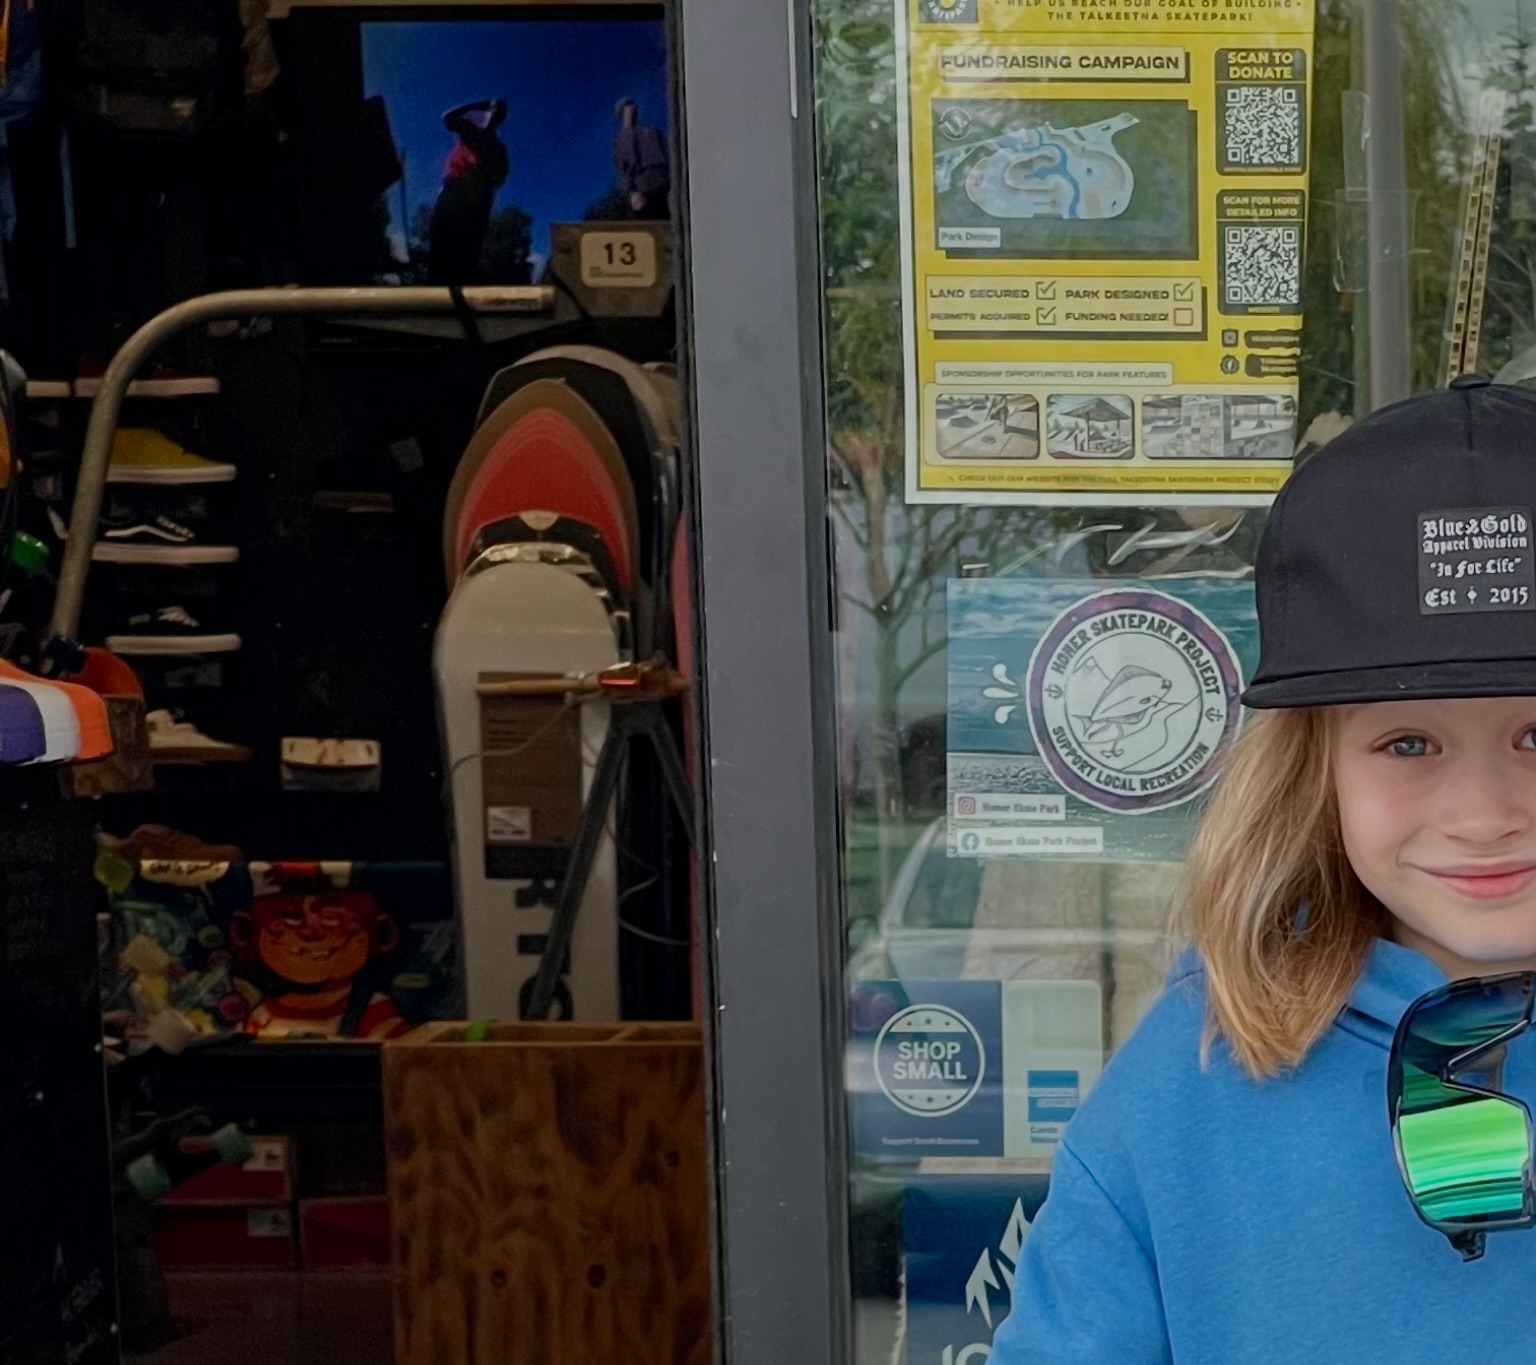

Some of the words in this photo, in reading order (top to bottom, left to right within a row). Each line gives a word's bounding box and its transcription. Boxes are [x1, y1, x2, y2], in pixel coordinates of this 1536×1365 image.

[1158, 0, 1195, 8] GOAL
[1225, 0, 1292, 8] BUILDING
[1047, 11, 1073, 21] THE
[1079, 12, 1159, 21] TALKEETNA
[1165, 12, 1253, 22] SKATEPARK!
[940, 55, 1072, 69] FUNDRAISING
[1078, 56, 1180, 70] CAMPAIGN
[1227, 51, 1269, 65] SCAN
[1272, 52, 1294, 64] TO
[1228, 66, 1293, 80] DONATE
[1223, 196, 1249, 206] SCAN
[1251, 196, 1271, 205] FOR
[1272, 196, 1300, 205] MORE
[1226, 208, 1272, 217] DETAILED
[1274, 208, 1298, 217] INFO
[941, 232, 963, 241] Park
[965, 232, 998, 243] Design
[603, 242, 637, 266] 13
[929, 288, 965, 299] LAND
[969, 289, 1030, 299] SECURED
[1065, 289, 1100, 299] PARK
[1104, 290, 1169, 300] DESIGNED
[930, 312, 976, 321] PERMITS
[1065, 312, 1117, 321] FUNDING
[1119, 312, 1169, 321] NEEDED!
[941, 369, 1002, 378] SPONSORSHIP
[1004, 369, 1075, 378] OPPORTUNITIES
[1076, 370, 1095, 378] FOR
[1096, 370, 1121, 379] PARK
[1122, 371, 1167, 379] FEATURES
[1422, 536, 1470, 556] Apparel
[1472, 533, 1528, 550] Division
[1455, 560, 1482, 578] For
[1424, 587, 1457, 607] Est
[1489, 586, 1529, 605] 2015
[1050, 630, 1091, 676] HOMER
[1091, 613, 1177, 642] SKATEPARK
[1175, 632, 1222, 696] PROJECT
[1052, 725, 1097, 778] SUPPORT
[1095, 769, 1137, 793] LOCAL
[1139, 741, 1210, 793] RECREATION
[1039, 803, 1060, 813] Park
[1042, 837, 1063, 846] Park
[897, 1040, 962, 1061] SHOP
[893, 1061, 968, 1081] SMALL
